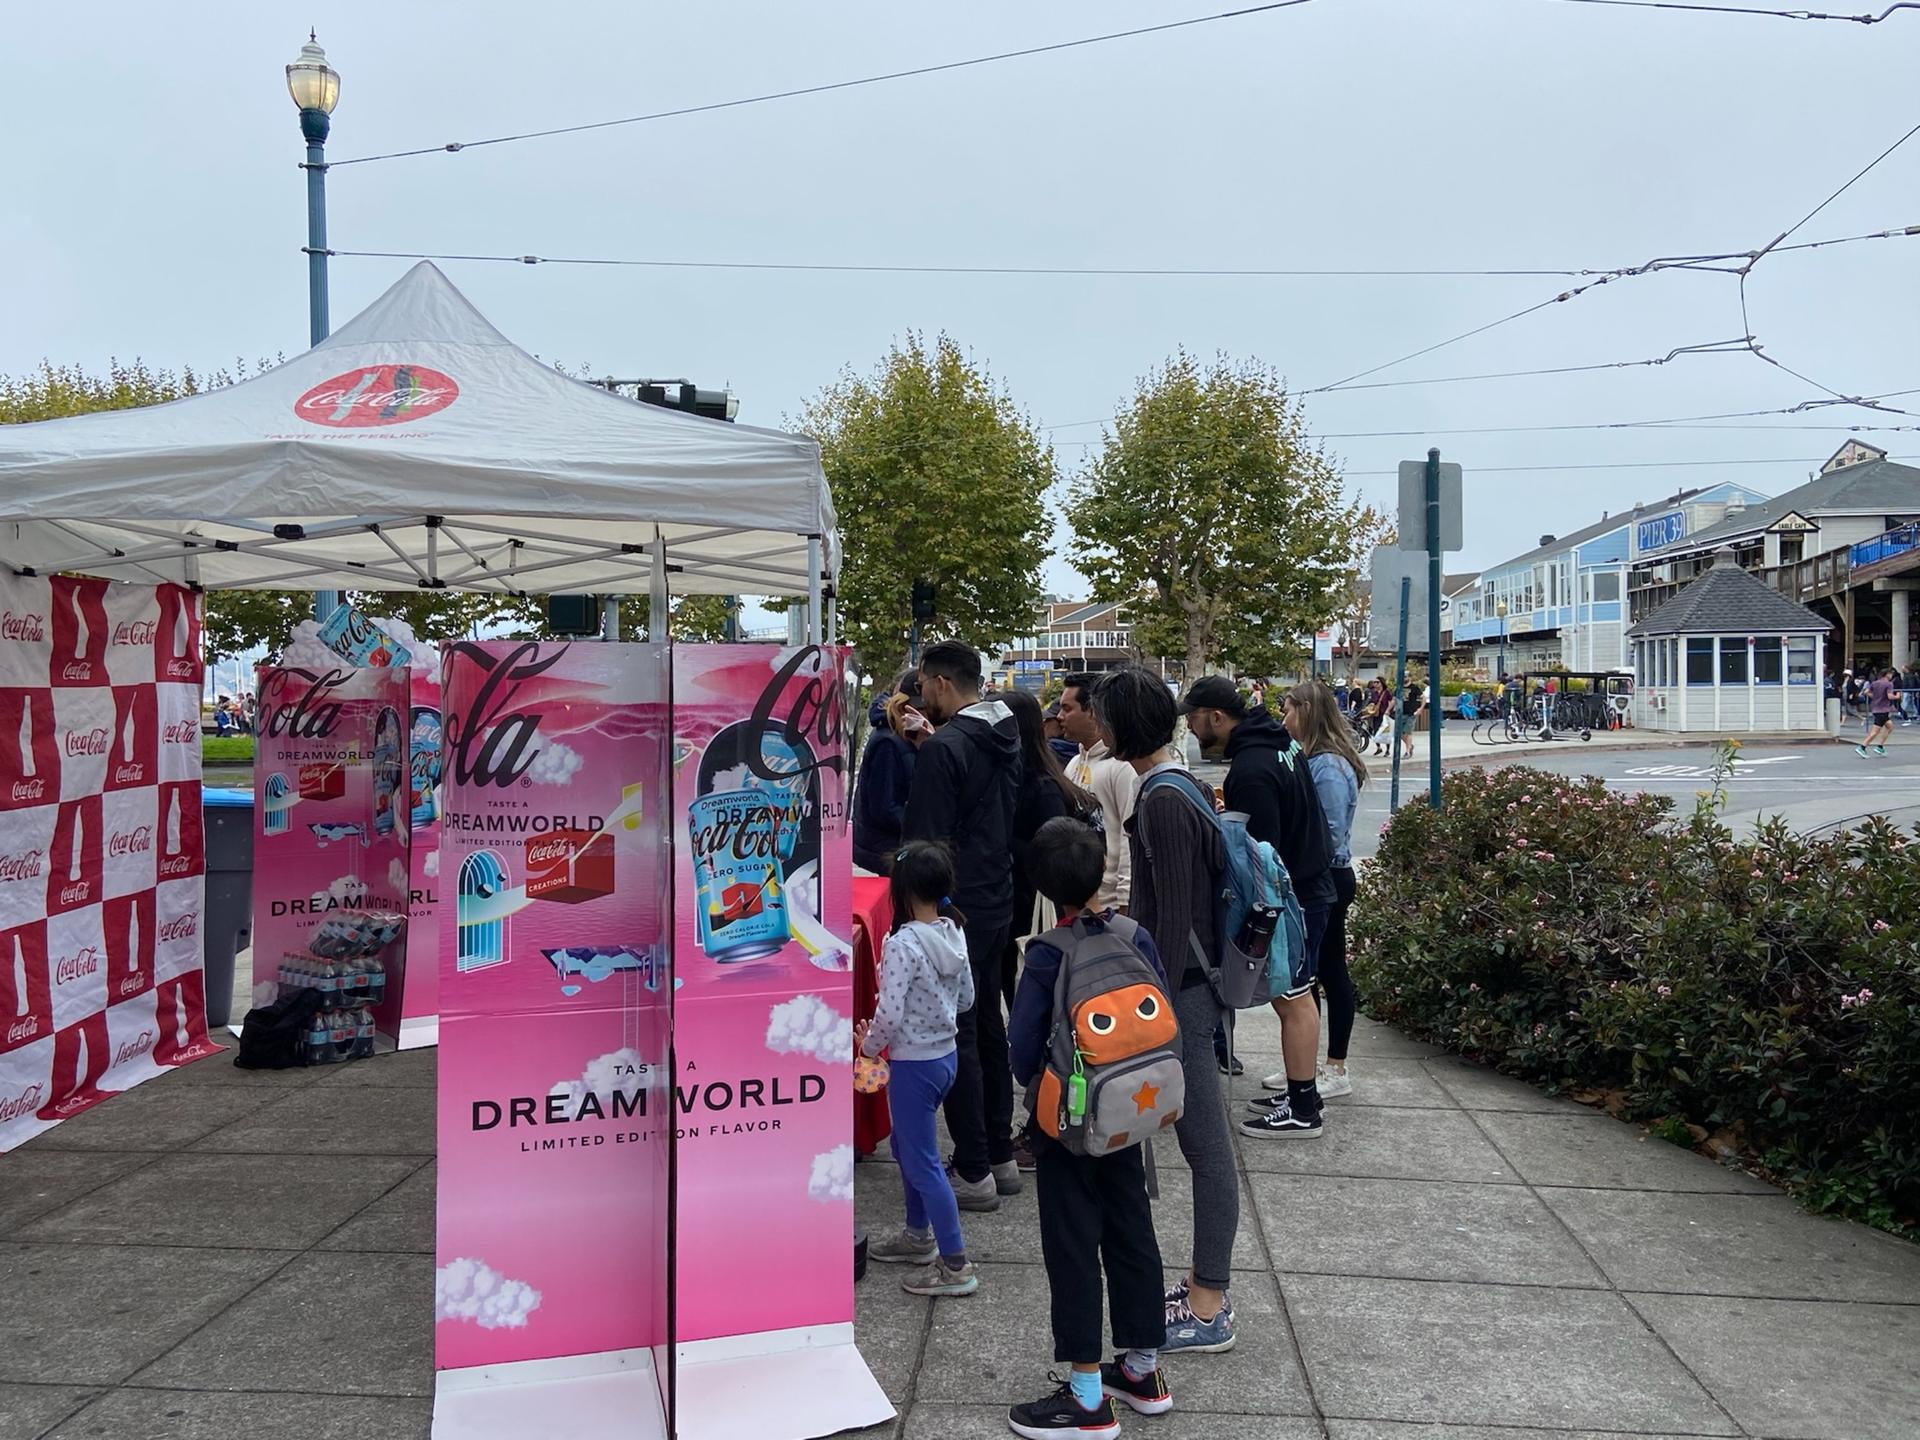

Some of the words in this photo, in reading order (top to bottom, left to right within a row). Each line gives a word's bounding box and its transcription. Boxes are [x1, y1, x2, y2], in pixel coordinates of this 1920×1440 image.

[1640, 520, 1667, 549] PIER
[1669, 514, 1682, 542] 39
[277, 751, 376, 760] DREAMWORLD
[701, 794, 760, 810] Dreamworld
[716, 802, 844, 825] DREAMWRLD
[445, 813, 604, 832] DREAMWORLD
[456, 838, 485, 846] LIMITED
[707, 867, 734, 880] ZERO
[738, 863, 772, 873] SUGAR
[529, 877, 567, 892] CREATIONS
[686, 1061, 697, 1071] A
[521, 1135, 605, 1152] LIMITED
[710, 1120, 781, 1135] FLAVOR
